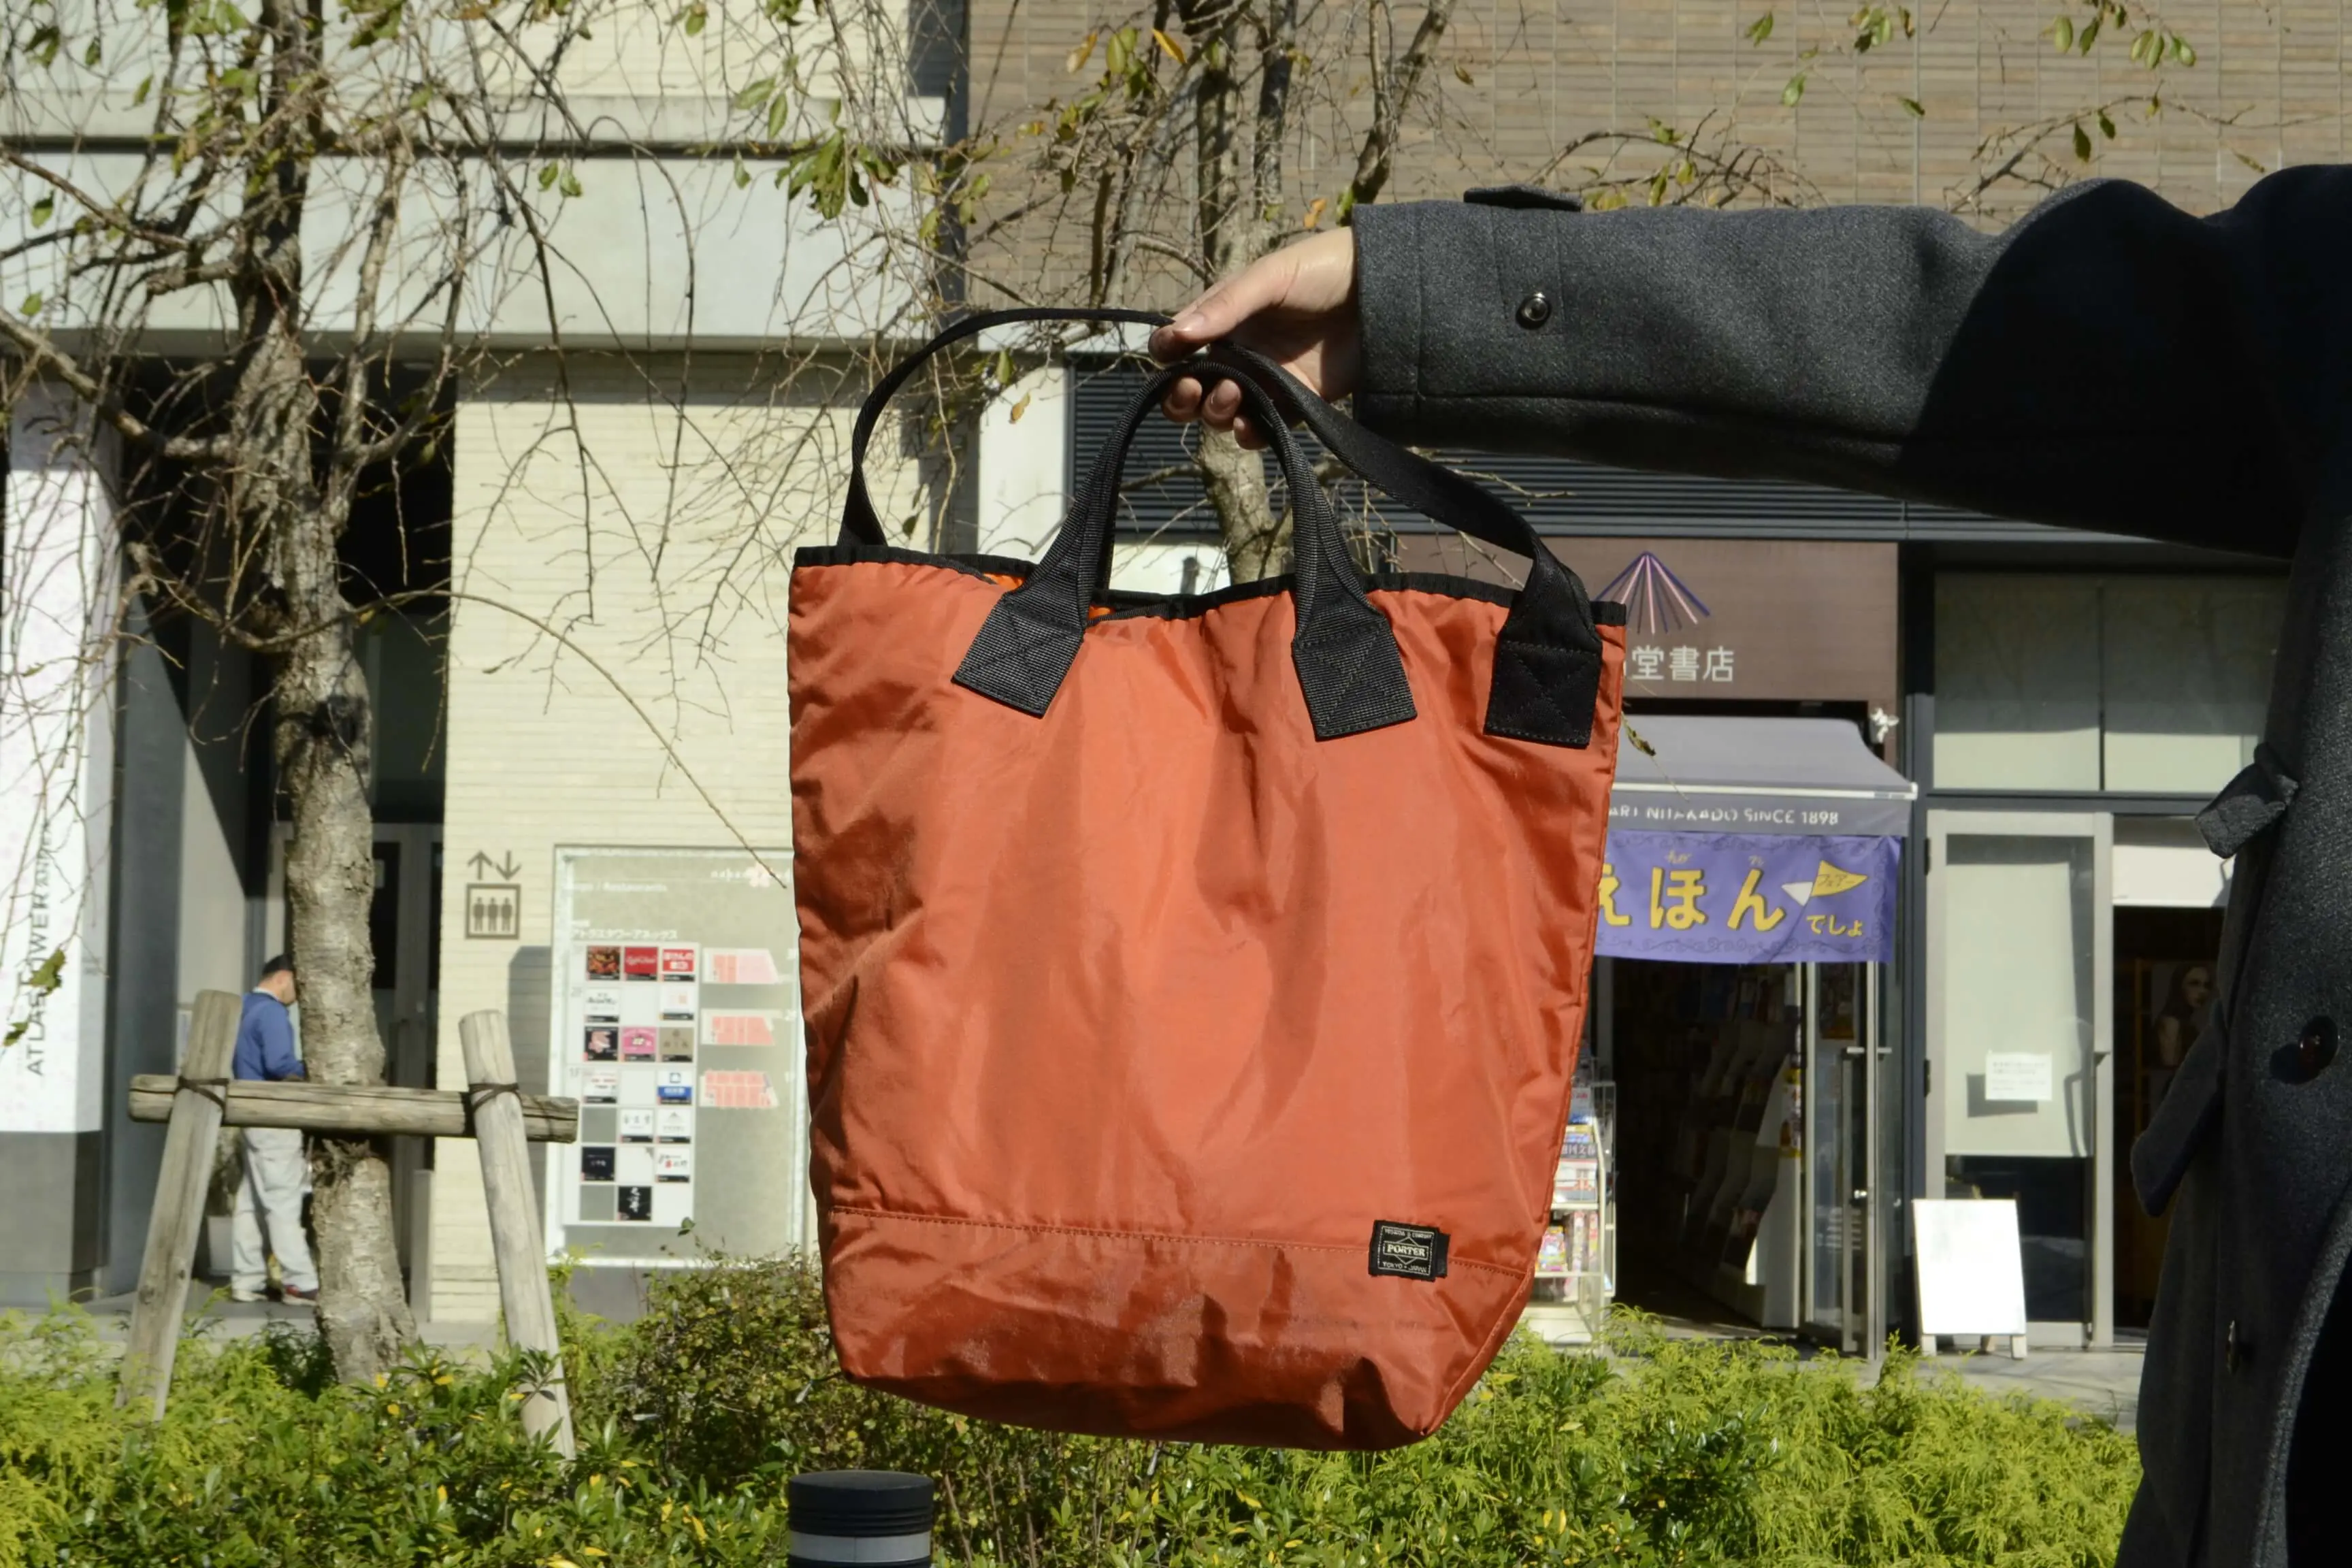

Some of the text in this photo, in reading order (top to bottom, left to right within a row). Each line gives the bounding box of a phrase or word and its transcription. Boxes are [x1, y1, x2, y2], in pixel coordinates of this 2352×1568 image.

[1623, 644, 1735, 682] 堂書店
[1744, 808, 1795, 823] SINCE
[1801, 810, 1839, 826] 1898
[1806, 914, 1863, 937] でしょ
[29, 893, 48, 987] OWER
[1387, 1244, 1425, 1257] PORTER
